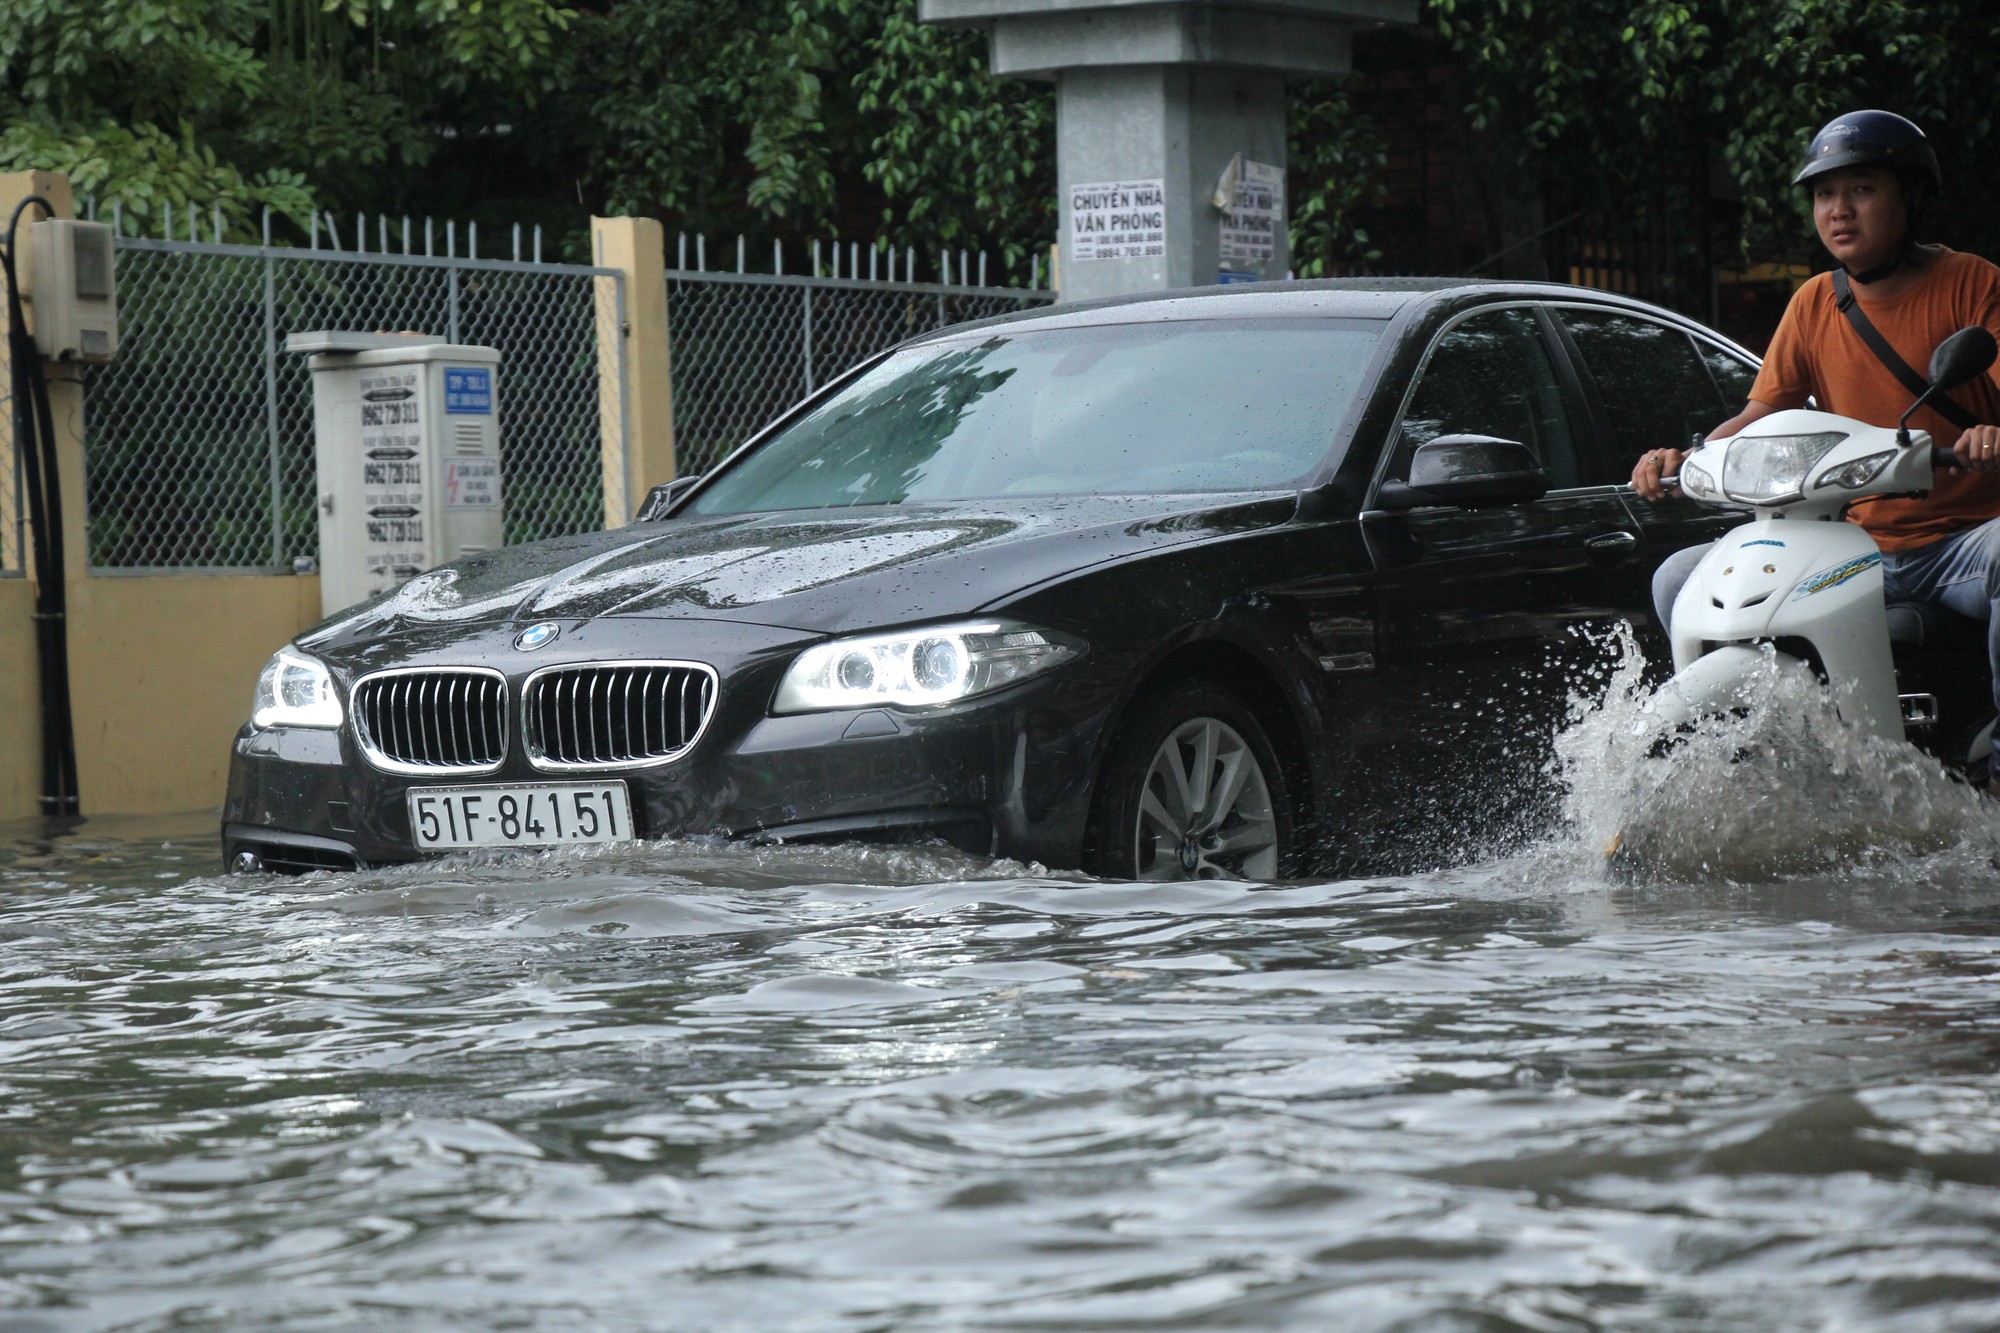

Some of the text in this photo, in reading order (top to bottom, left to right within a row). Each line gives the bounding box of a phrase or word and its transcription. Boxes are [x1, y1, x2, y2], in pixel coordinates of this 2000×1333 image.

[1075, 207, 1163, 232] VĂN PHÒNG
[416, 790, 617, 842] 51F-841.51
